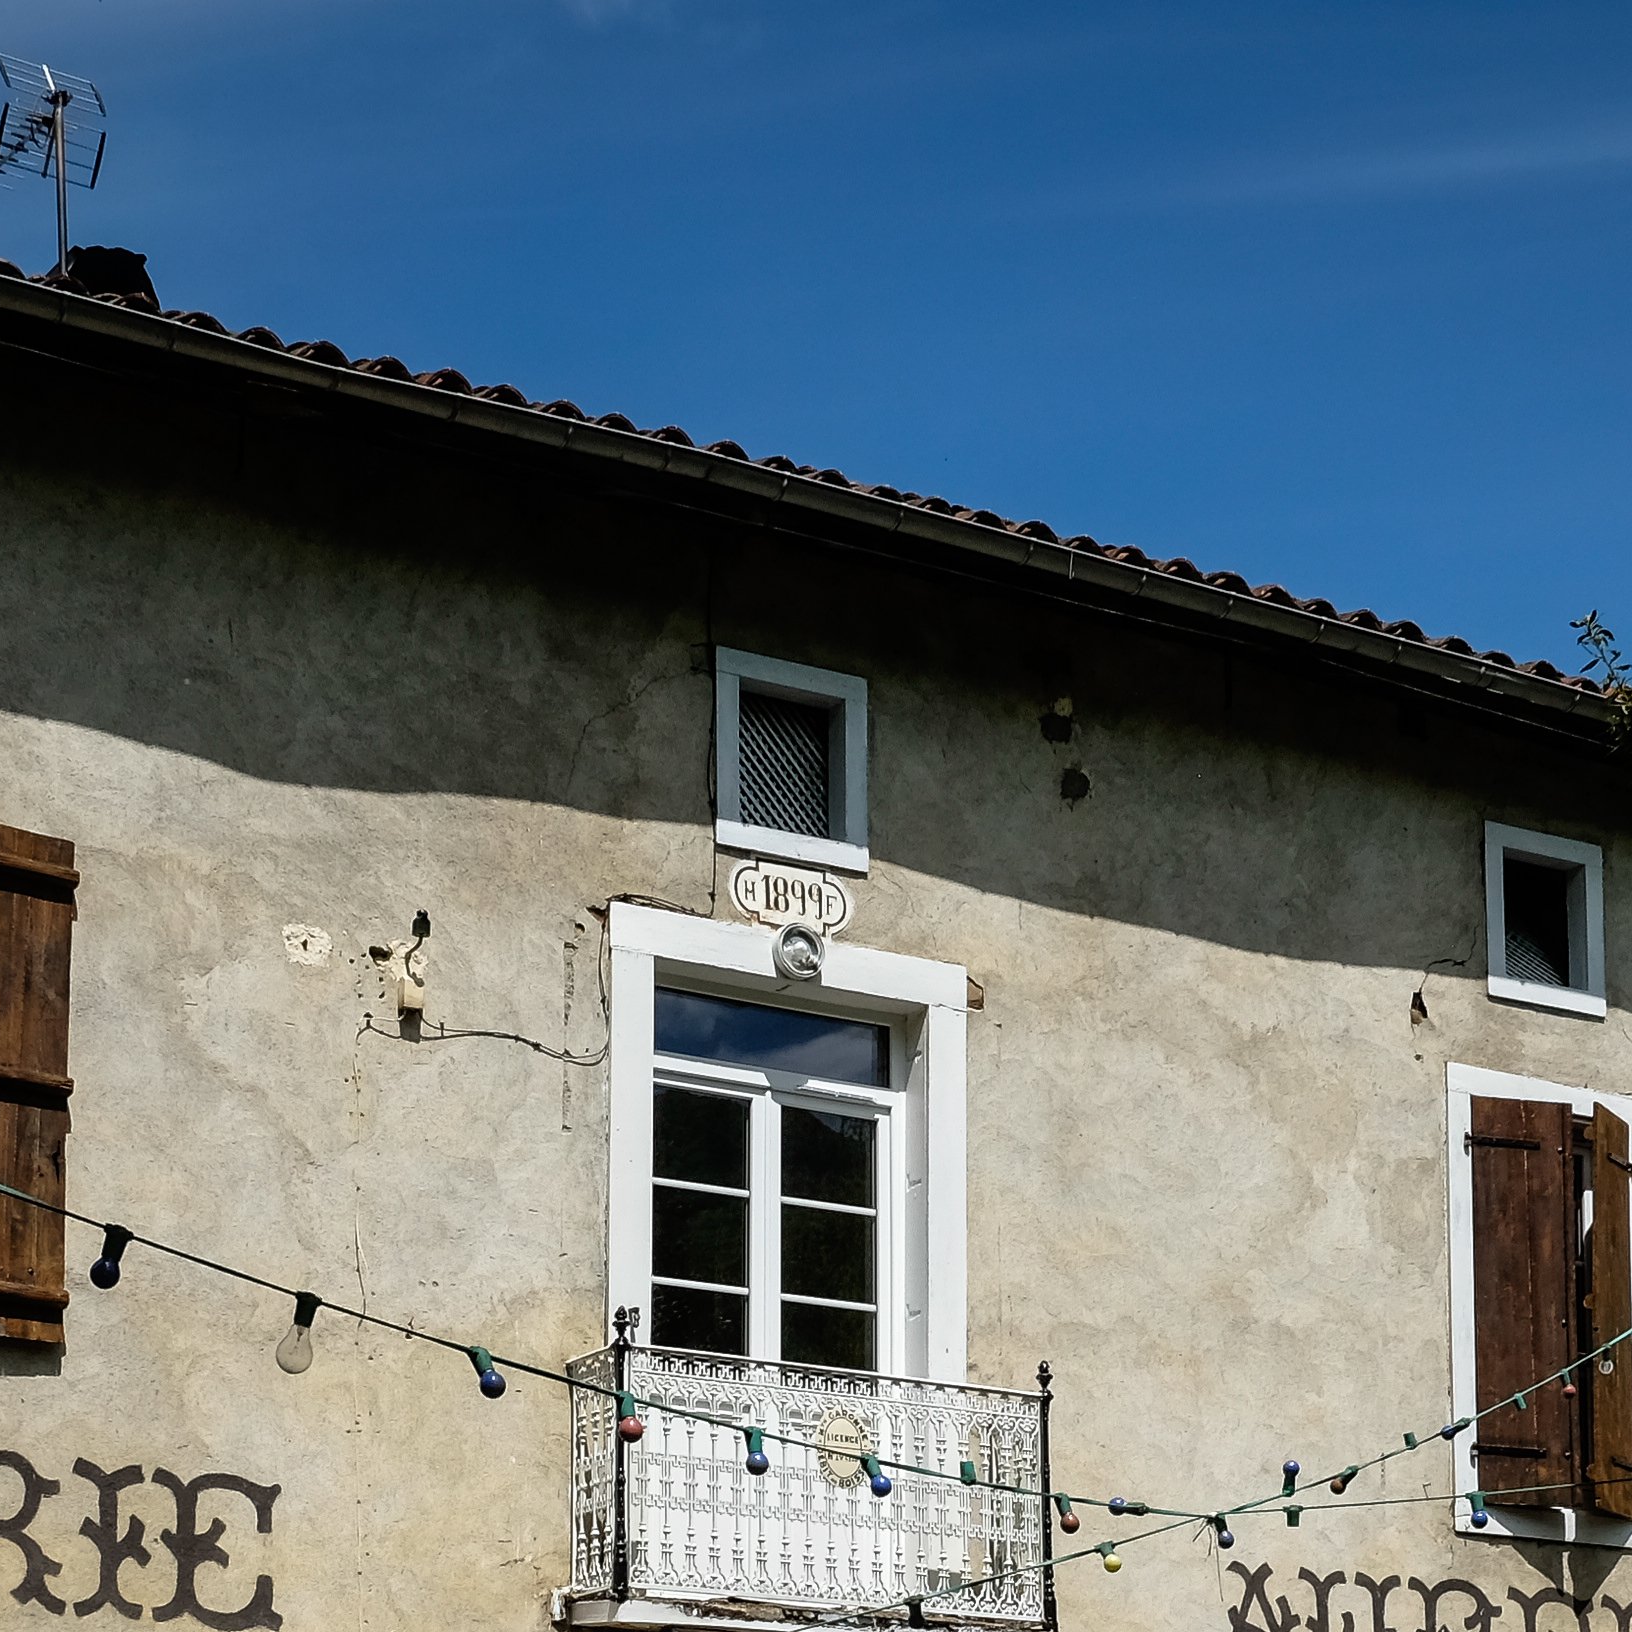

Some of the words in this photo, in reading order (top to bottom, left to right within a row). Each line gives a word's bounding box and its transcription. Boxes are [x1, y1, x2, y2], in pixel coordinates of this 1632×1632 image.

[761, 874, 824, 920] 1899
[826, 895, 838, 915] F
[827, 1432, 859, 1444] LICENCE
